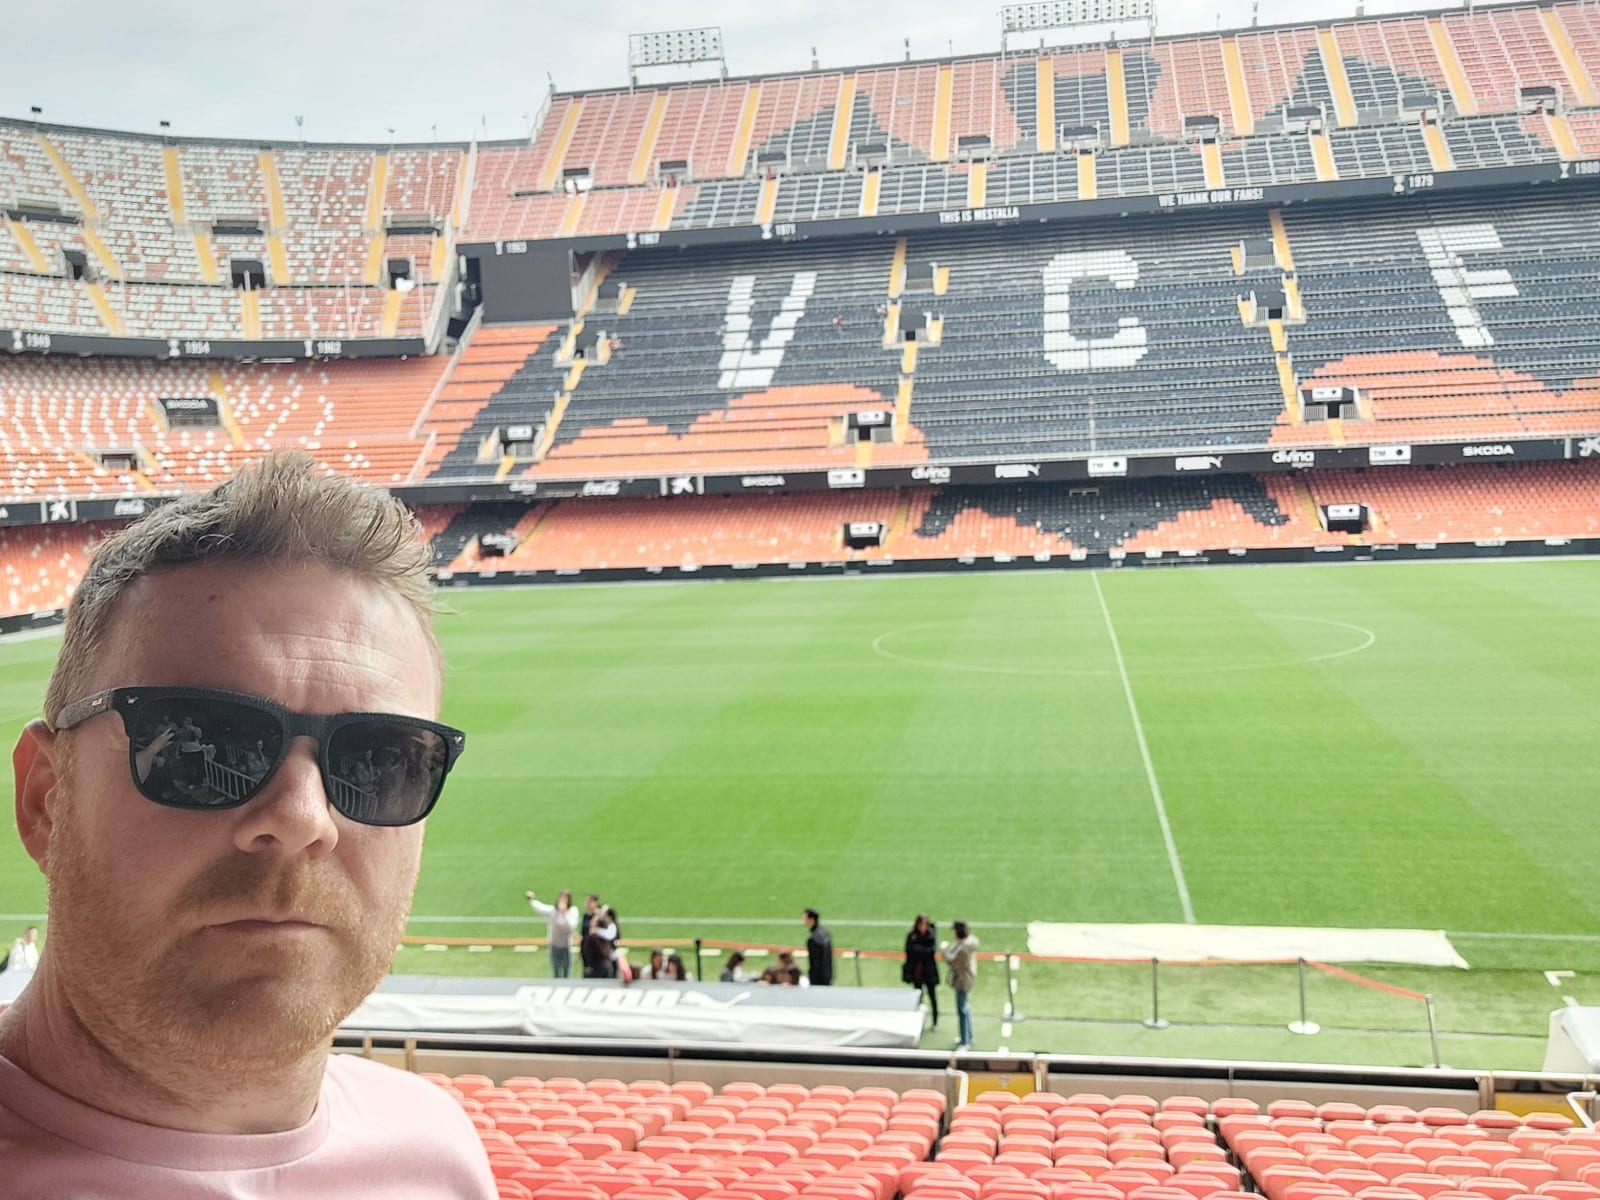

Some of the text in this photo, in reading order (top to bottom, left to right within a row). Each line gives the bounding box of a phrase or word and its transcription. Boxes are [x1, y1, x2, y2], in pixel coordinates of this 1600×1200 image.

[1408, 174, 1434, 188] 1979
[1176, 191, 1209, 205] THANK
[1210, 189, 1232, 203] OUR
[1233, 187, 1264, 201] FANS!
[939, 206, 1020, 224] THIS IS MESTALLA
[1042, 250, 1148, 370] C
